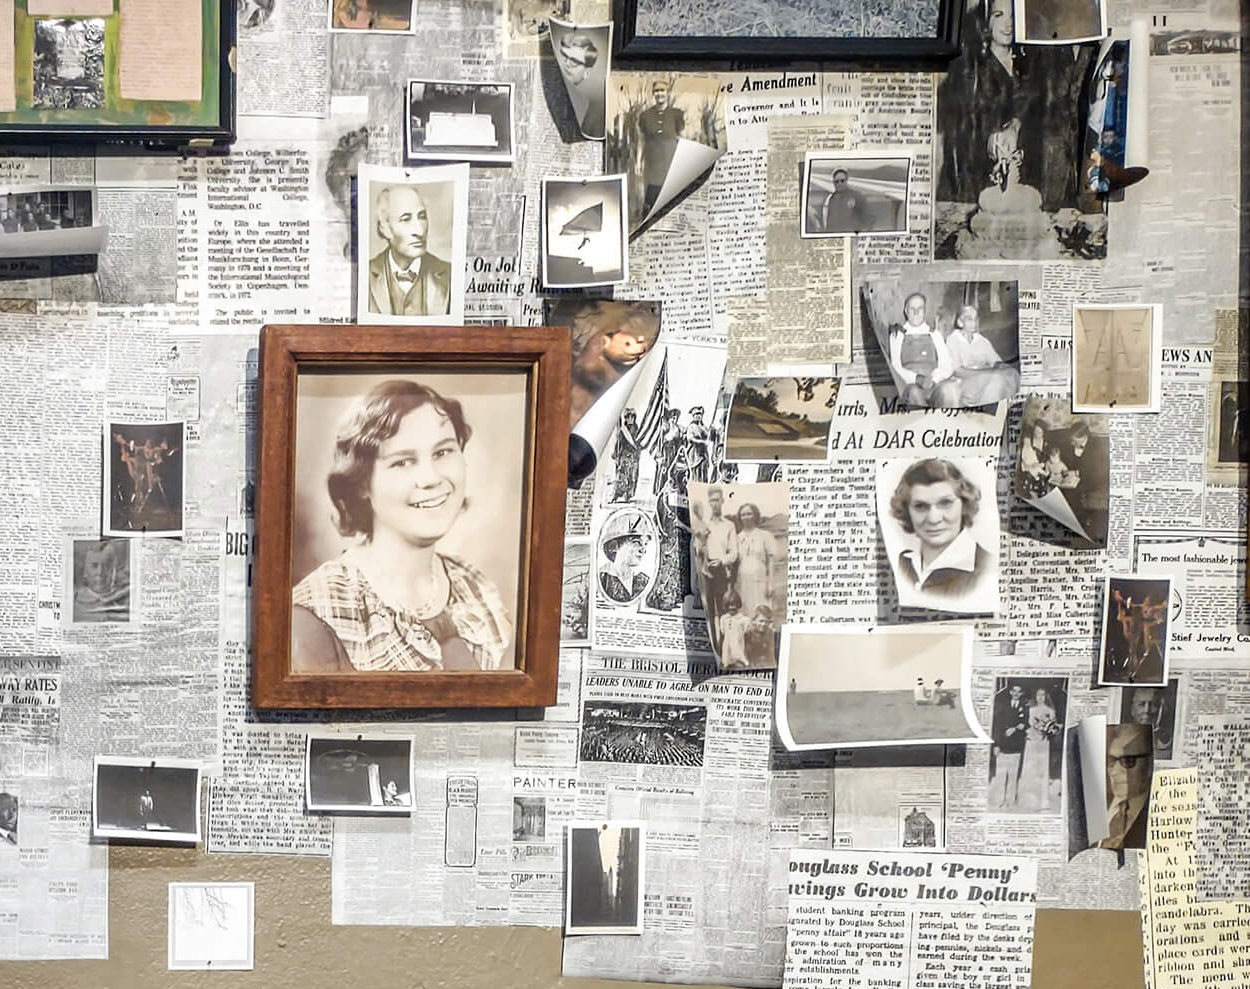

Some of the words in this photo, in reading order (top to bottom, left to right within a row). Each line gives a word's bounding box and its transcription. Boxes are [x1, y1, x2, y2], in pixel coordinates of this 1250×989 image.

[740, 72, 816, 92] Amendment
[733, 103, 774, 113] Governor
[779, 99, 795, 109] and
[473, 257, 491, 273] On
[1161, 349, 1190, 362] EWS
[1195, 349, 1213, 362] AN
[844, 433, 863, 449] At
[873, 430, 915, 448] DAR
[922, 428, 1003, 448] Celebration
[225, 533, 249, 556] BIG
[1142, 553, 1158, 562] The
[1184, 554, 1228, 564] fashionable
[1171, 633, 1192, 642] Stief
[1196, 634, 1231, 644] Jewelry
[601, 657, 627, 670] THE
[631, 658, 682, 674] BRISTOL
[24, 678, 58, 691] RATES
[585, 677, 620, 687] LEADERS
[622, 679, 653, 689] UNABLE
[656, 681, 667, 690] TO
[670, 681, 696, 692] AGREE
[698, 684, 710, 693] ON
[711, 685, 730, 694] MAN
[733, 686, 743, 695] TO
[746, 687, 762, 696] END
[513, 777, 576, 789] PAINTER
[1169, 789, 1187, 798] the
[1150, 816, 1192, 827] Harlow
[1151, 830, 1193, 840] Hunter
[1152, 844, 1169, 854] the
[1166, 856, 1179, 866] At
[866, 860, 933, 877] School
[1154, 870, 1176, 880] into
[854, 882, 908, 899] Grow
[916, 884, 958, 900] Into
[966, 885, 1037, 903] Dollars
[832, 907, 864, 916] banking
[839, 919, 874, 927] Douglass
[1156, 923, 1176, 934] day
[1183, 921, 1206, 930] was
[1219, 931, 1240, 941] and
[1158, 951, 1187, 961] place
[1158, 961, 1195, 973] ribbon
[1203, 959, 1225, 970] and
[868, 979, 901, 987] banking
[1170, 975, 1193, 985] The
[1202, 972, 1234, 983] menu
